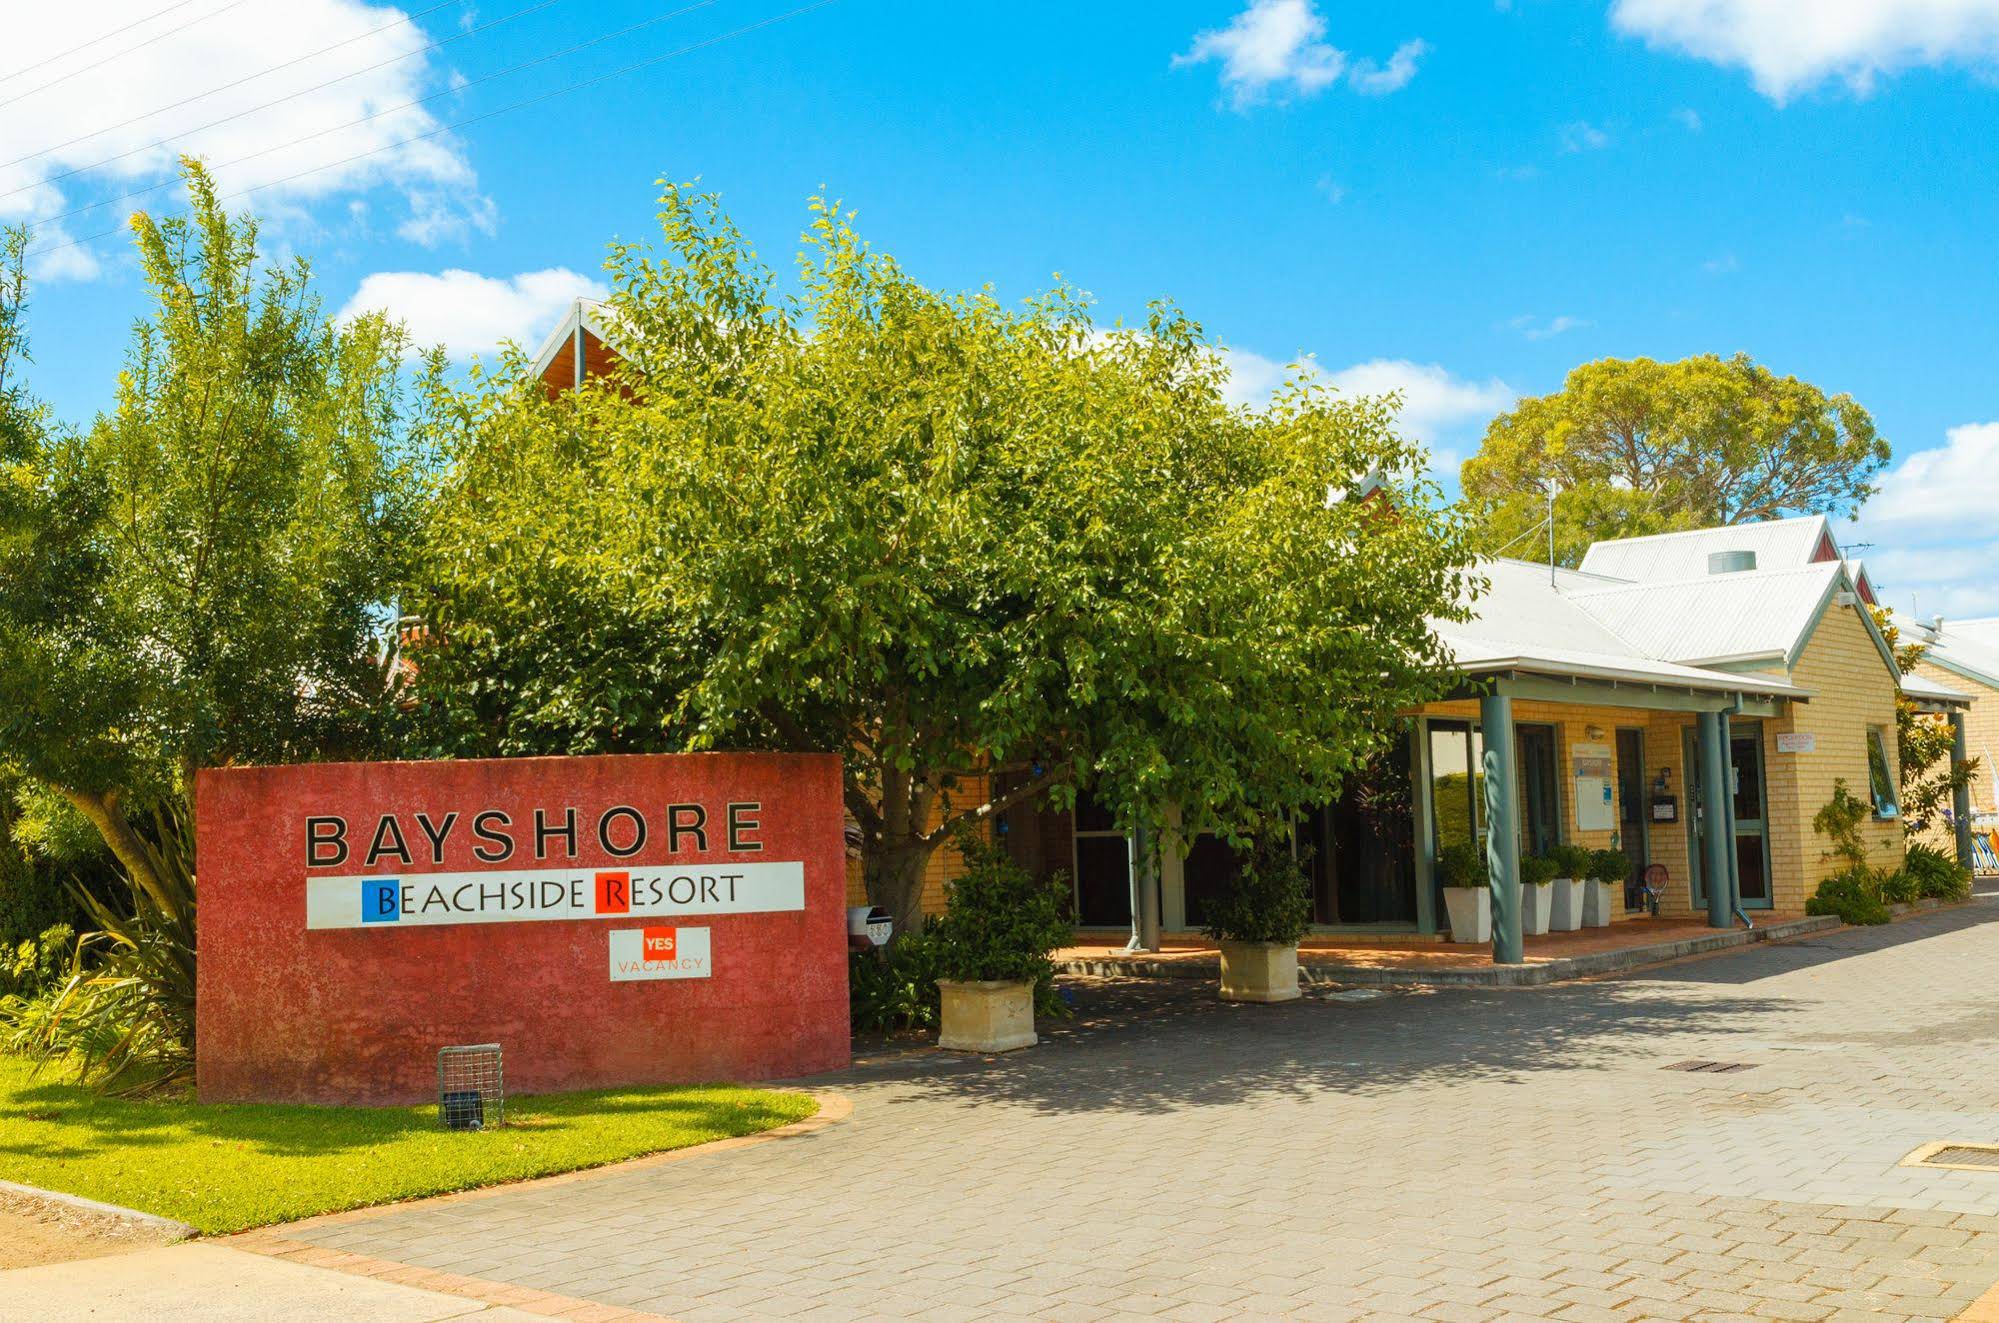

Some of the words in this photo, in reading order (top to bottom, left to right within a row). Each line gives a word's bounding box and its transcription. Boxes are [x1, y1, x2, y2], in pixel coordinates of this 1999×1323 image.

[306, 802, 764, 867] BAYSHORE
[378, 879, 585, 915] BEACHSIDE
[605, 875, 744, 907] RESORT
[645, 937, 674, 951] YES
[618, 957, 704, 973] VACANCY
